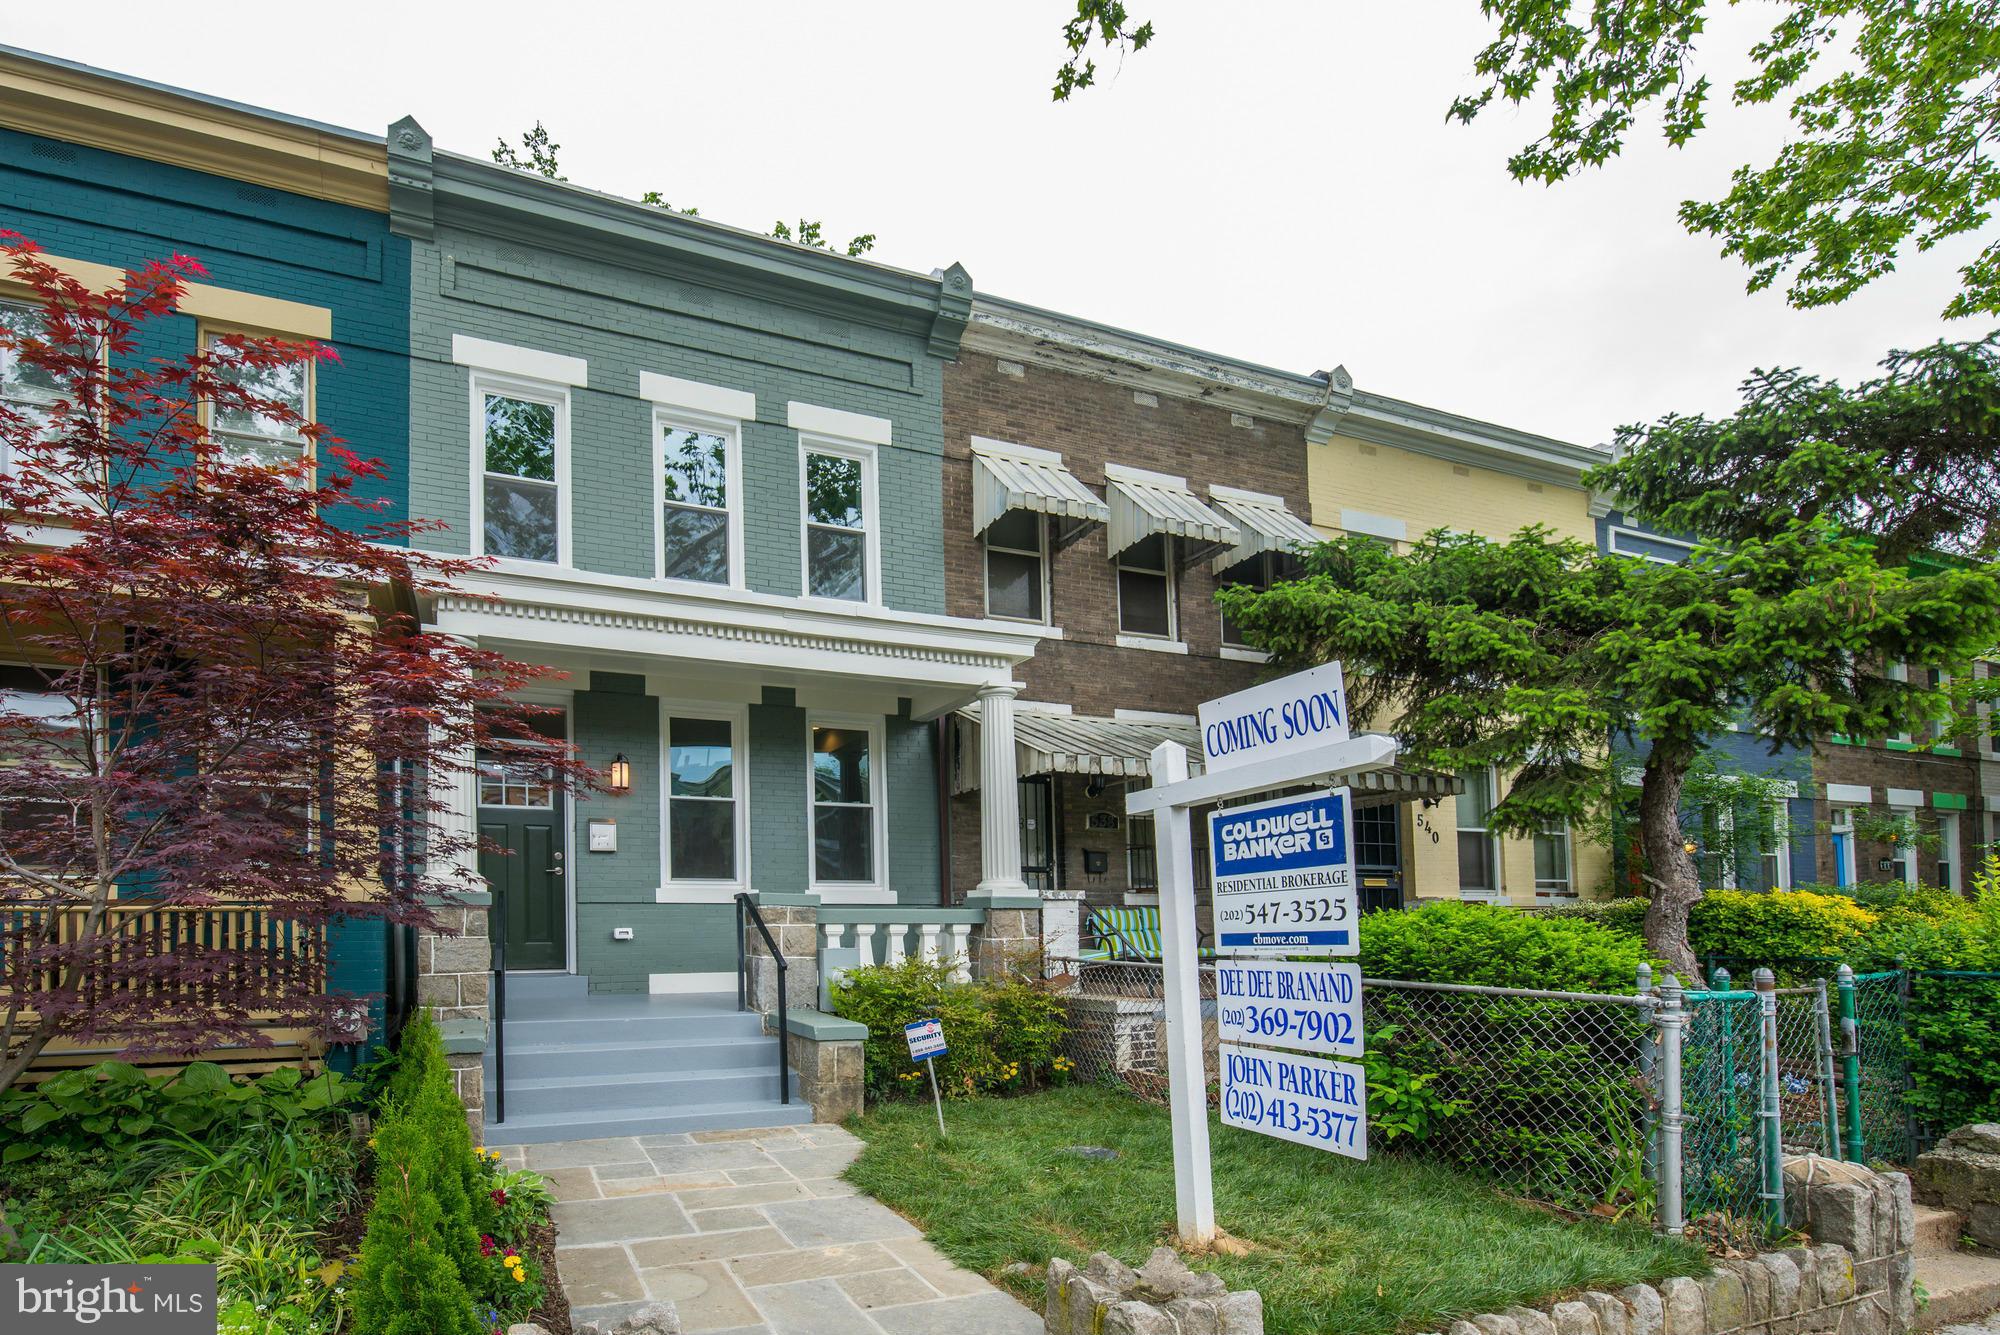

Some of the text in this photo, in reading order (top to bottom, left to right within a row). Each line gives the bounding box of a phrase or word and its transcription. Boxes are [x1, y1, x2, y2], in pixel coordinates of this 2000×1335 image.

[1206, 690, 1341, 757] COMING SOON
[1417, 814, 1439, 844] 540
[1217, 870, 1348, 894] RESIDENTIAL BROKERAGE
[1245, 898, 1347, 925] 547-3525
[1253, 933, 1309, 945] cbmove.com
[1220, 969, 1353, 1004] DEE DEE BRANAND
[909, 1032, 941, 1044] SECURITY
[1246, 1006, 1355, 1045] 369-7902
[1225, 1054, 1359, 1106] JOHN PARKER
[1266, 1098, 1359, 1147] 413-5377
